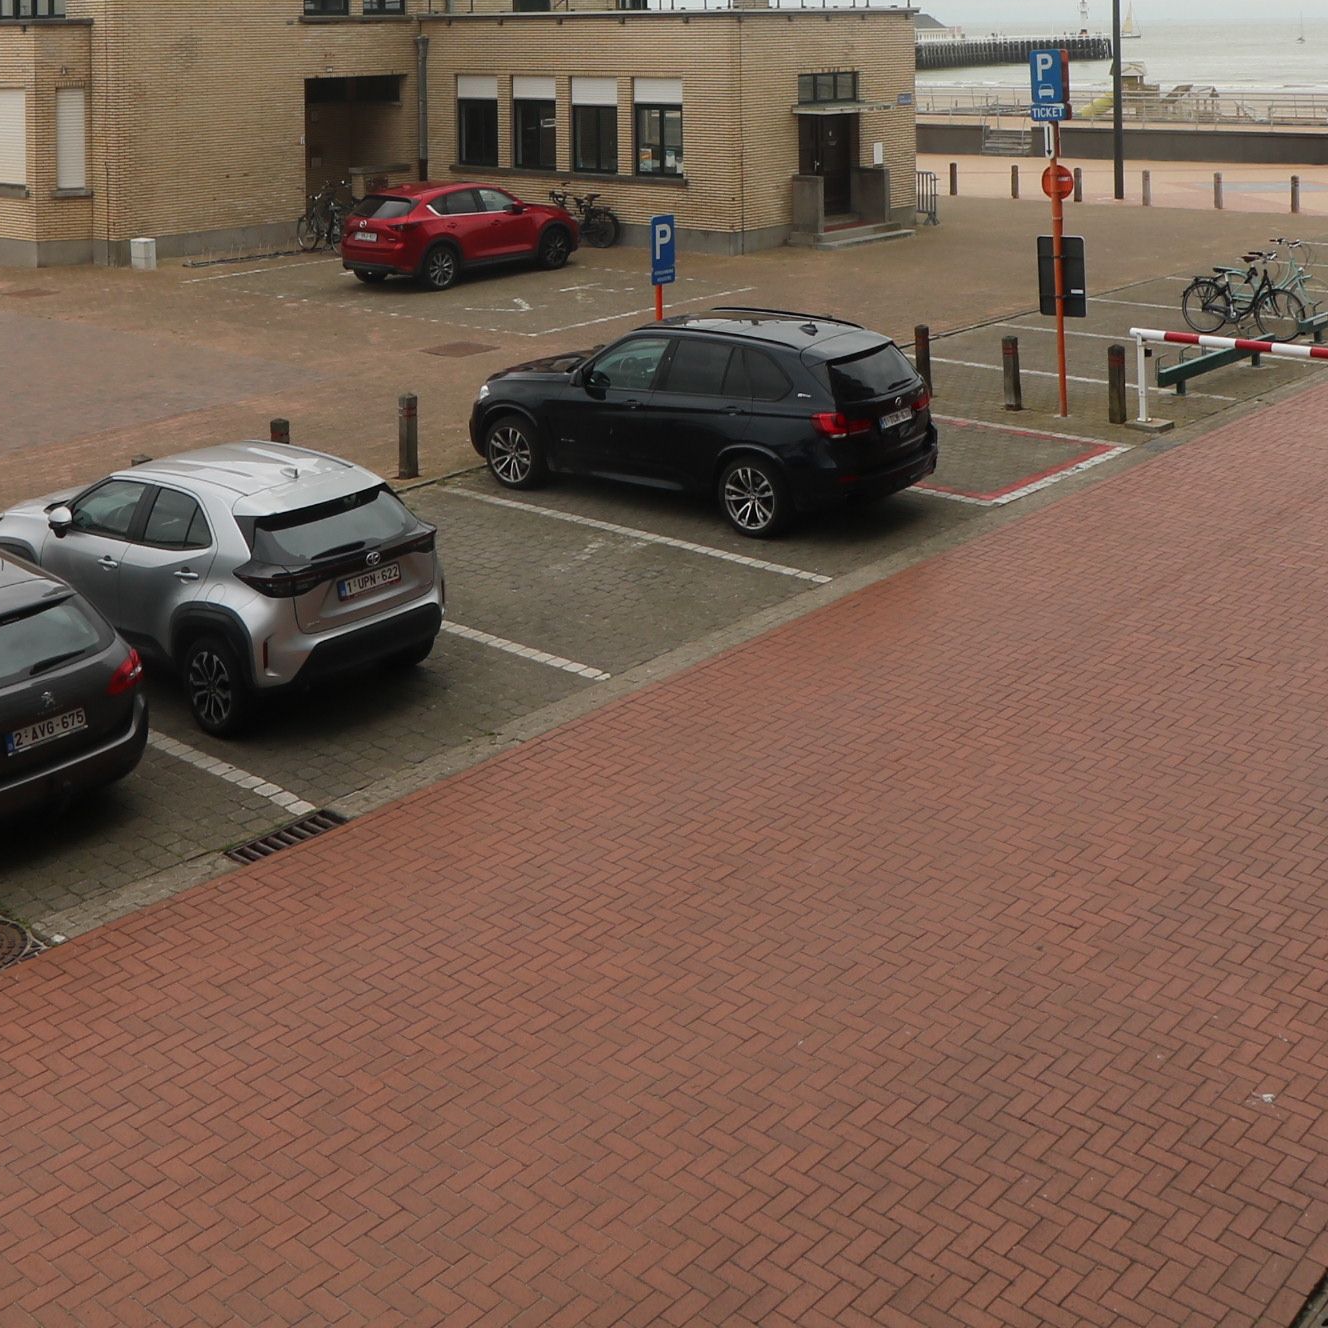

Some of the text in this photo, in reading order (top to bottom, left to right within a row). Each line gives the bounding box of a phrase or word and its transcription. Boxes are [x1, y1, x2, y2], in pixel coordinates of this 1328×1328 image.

[1036, 53, 1053, 81] P
[1032, 107, 1064, 119] TICKET
[655, 223, 672, 260] P
[14, 709, 84, 747] 2-AVG-675
